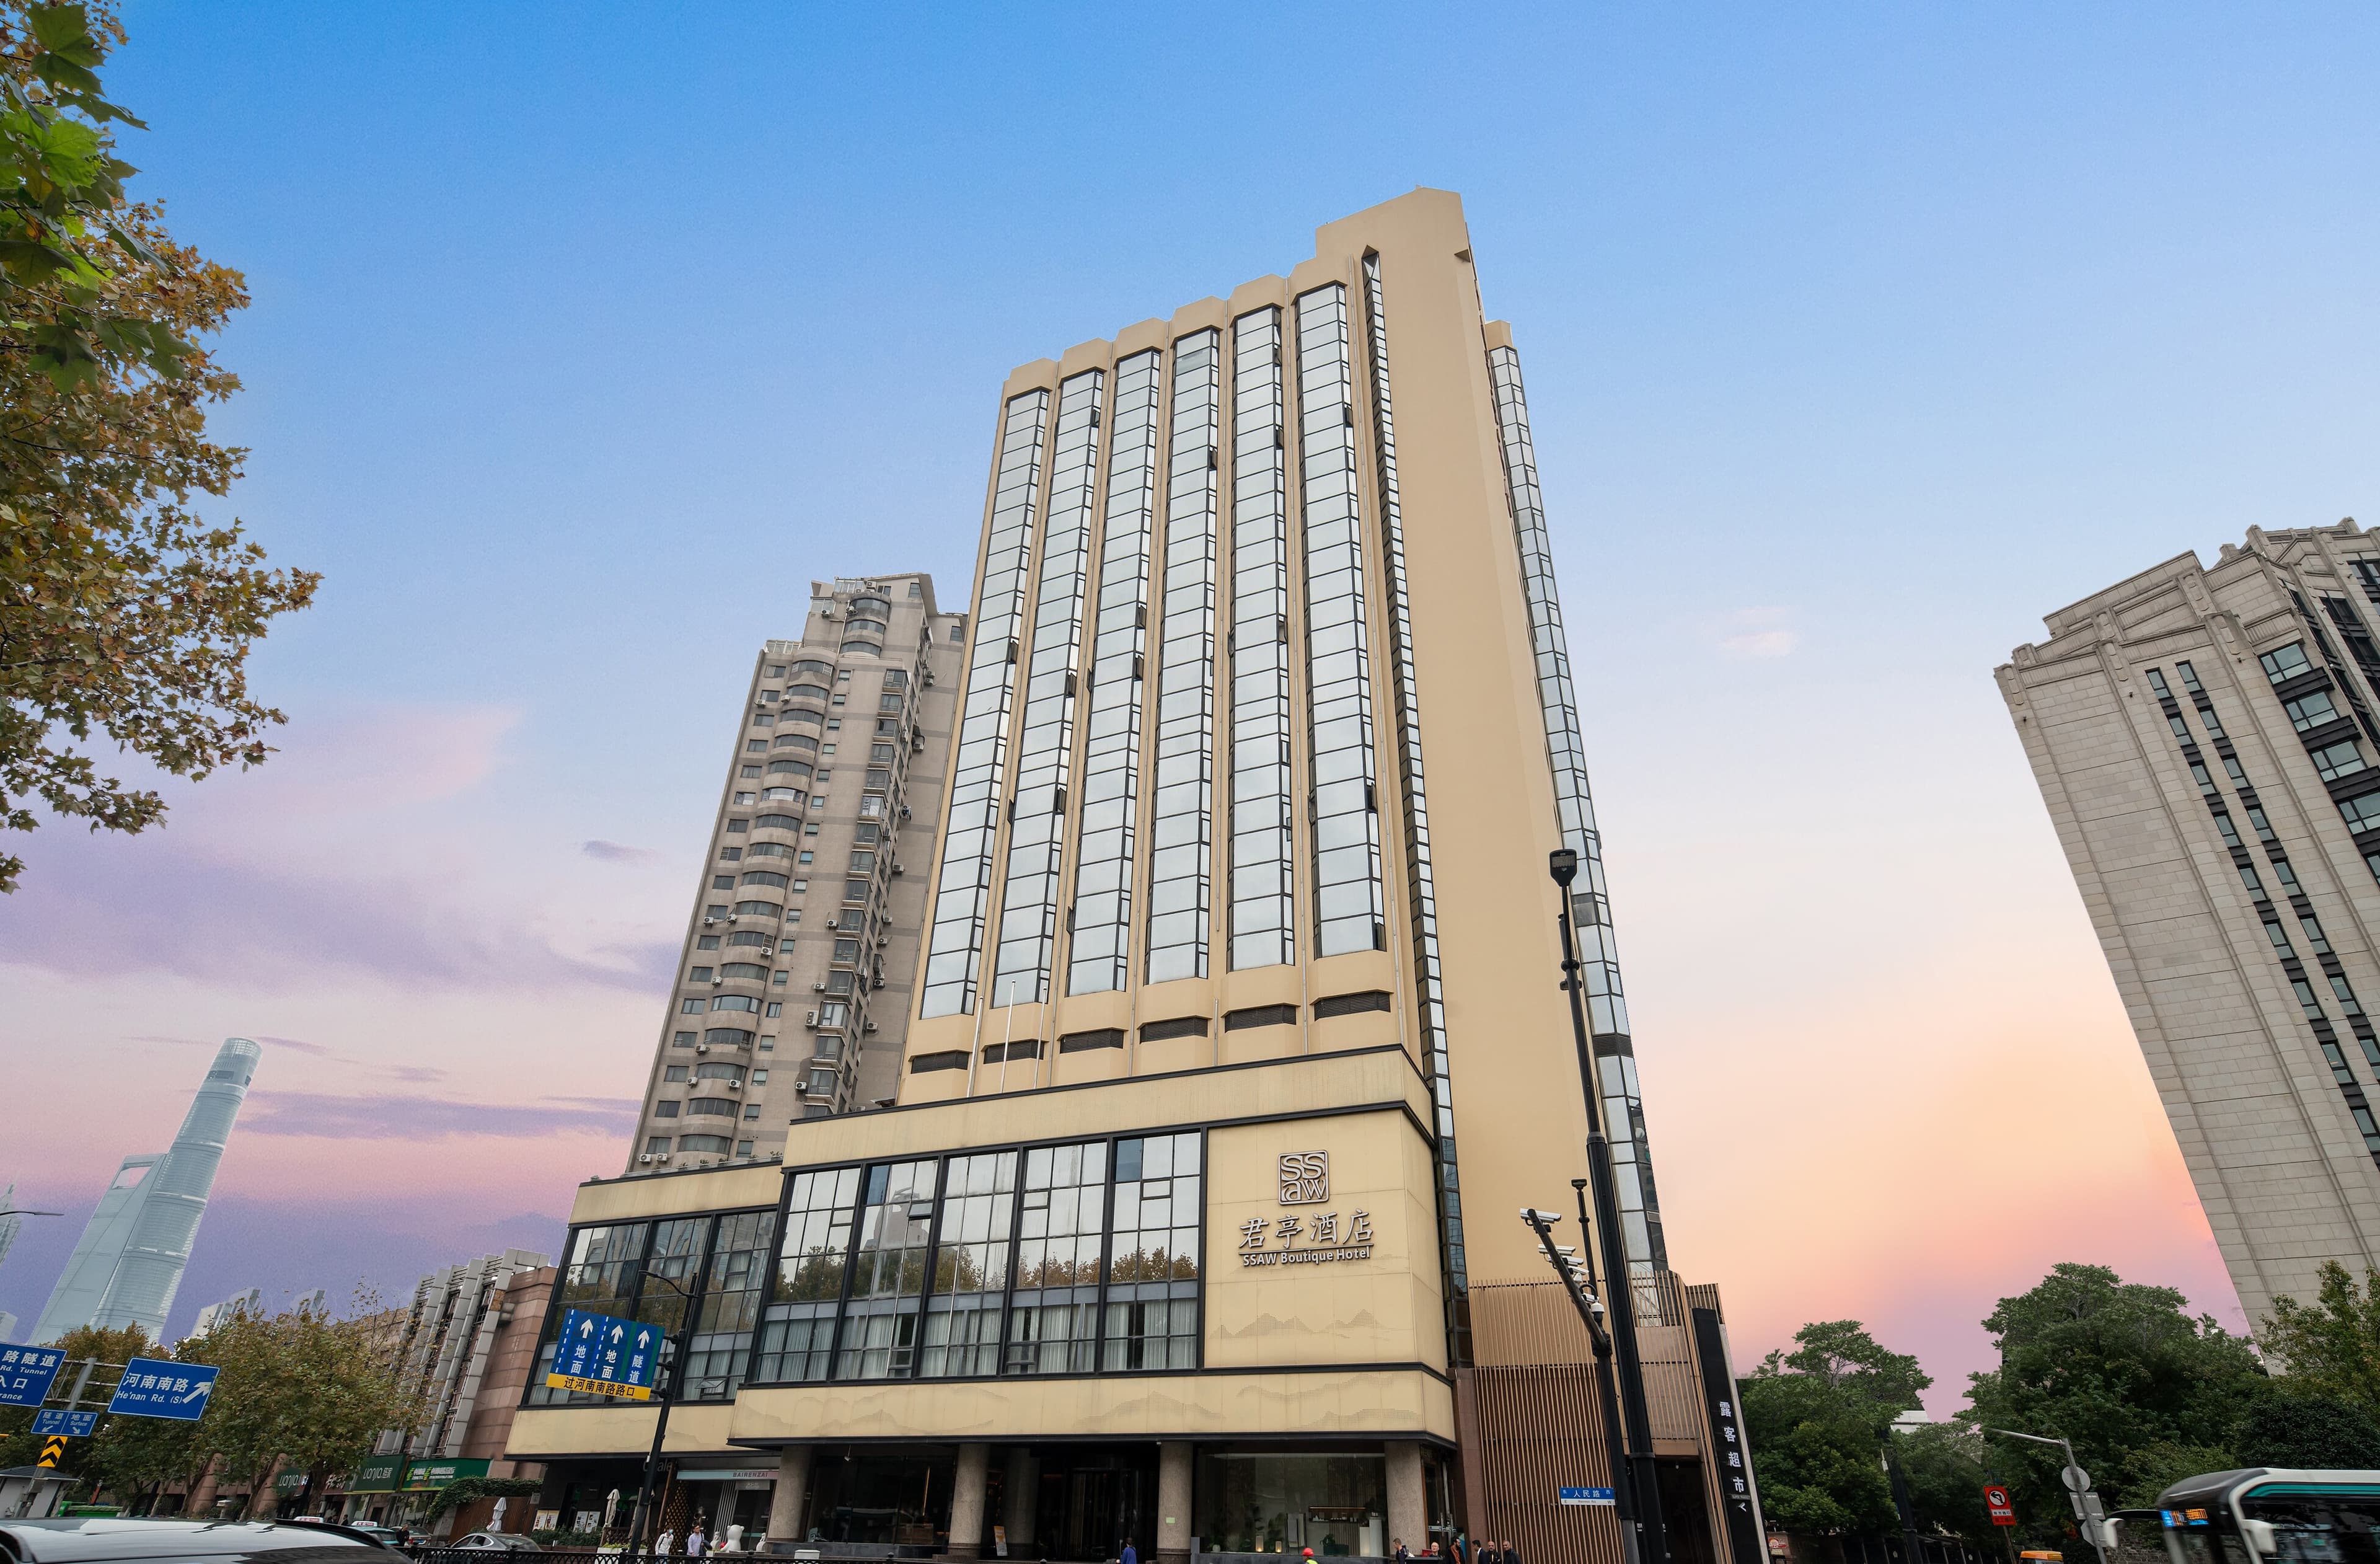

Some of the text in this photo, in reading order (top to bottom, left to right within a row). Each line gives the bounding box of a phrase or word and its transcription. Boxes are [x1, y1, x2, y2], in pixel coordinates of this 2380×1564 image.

[1238, 1209, 1374, 1249] 君亭酒店
[1243, 1245, 1370, 1266] SSAW Boutique Hotel
[1, 1350, 57, 1367] 路隧道
[570, 1344, 587, 1374] 地面
[601, 1349, 618, 1379] 地面
[20, 1367, 48, 1376] Tunnel
[628, 1354, 644, 1384] 隧道
[123, 1372, 189, 1393] 河南南路
[563, 1377, 635, 1396] 过河南南路路口
[116, 1390, 183, 1404] He'nan Rd. (S)
[42, 1412, 64, 1420] 隧道
[71, 1413, 94, 1421] 地面
[1719, 1401, 1745, 1493] 露客超市
[1574, 1490, 1600, 1498] 人民路
